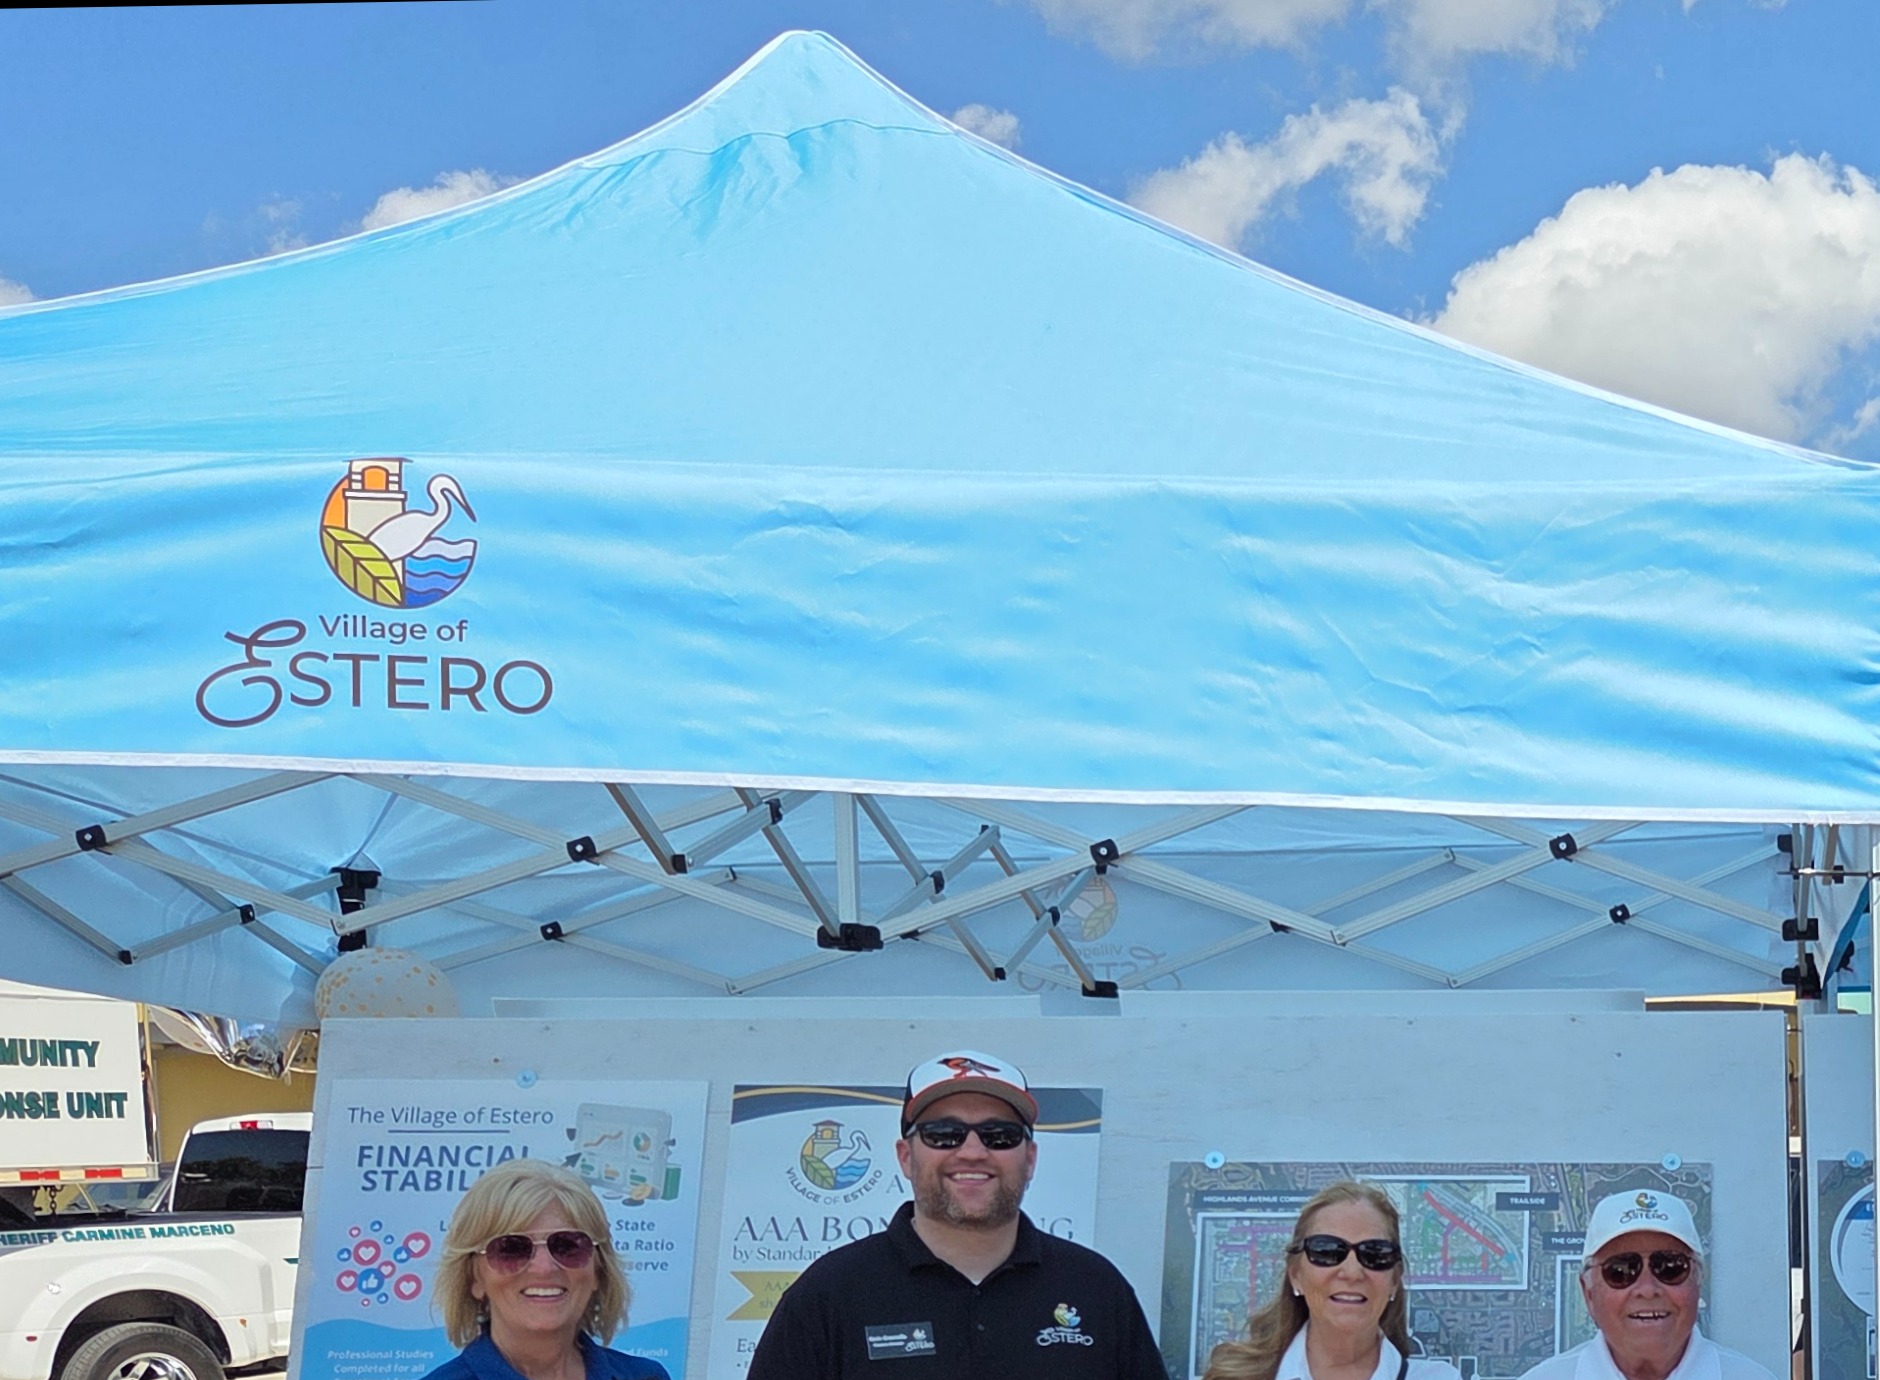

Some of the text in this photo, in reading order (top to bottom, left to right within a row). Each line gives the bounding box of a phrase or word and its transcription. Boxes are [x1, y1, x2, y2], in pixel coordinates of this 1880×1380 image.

[318, 614, 469, 645] Village of
[195, 619, 554, 728] ESTERO
[66, 1091, 128, 1120] UNIT
[347, 1106, 554, 1128] The Village of Estero
[360, 1170, 484, 1192] STABIL
[786, 1166, 822, 1204] VILLAGE
[823, 1195, 840, 1206] OF
[842, 1168, 884, 1204] ESTERO
[1509, 1197, 1547, 1206] TRAILSIDE
[61, 1226, 147, 1244] CARMINE
[149, 1223, 236, 1240] MARCENO
[615, 1218, 656, 1232] State
[733, 1216, 810, 1241] AAA
[634, 1238, 675, 1252] Ratio
[732, 1245, 750, 1263] by
